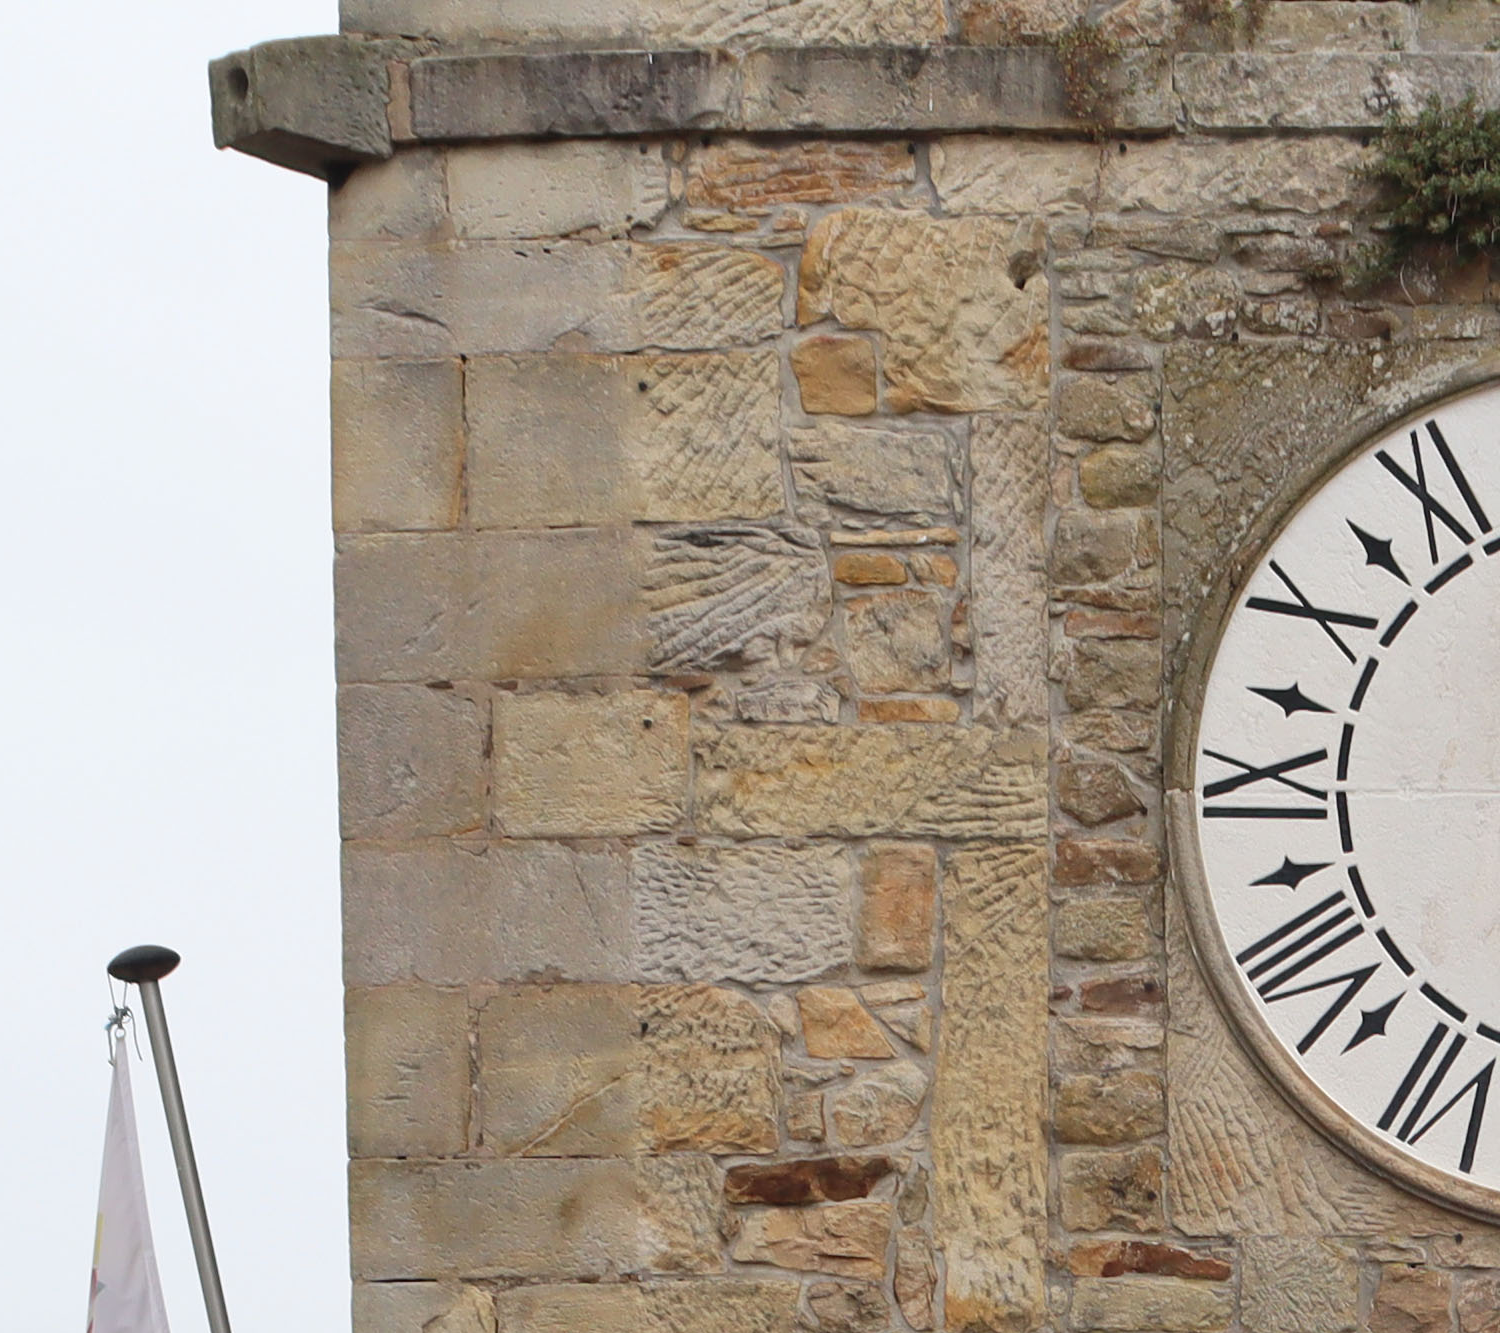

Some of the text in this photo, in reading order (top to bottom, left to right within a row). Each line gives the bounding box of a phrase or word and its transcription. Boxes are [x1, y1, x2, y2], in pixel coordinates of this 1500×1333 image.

[1375, 420, 1494, 565] XI
[1245, 560, 1378, 663] X
[1202, 748, 1328, 819] IX
[1236, 890, 1381, 1055] VIII
[1378, 1022, 1495, 1172] VII
